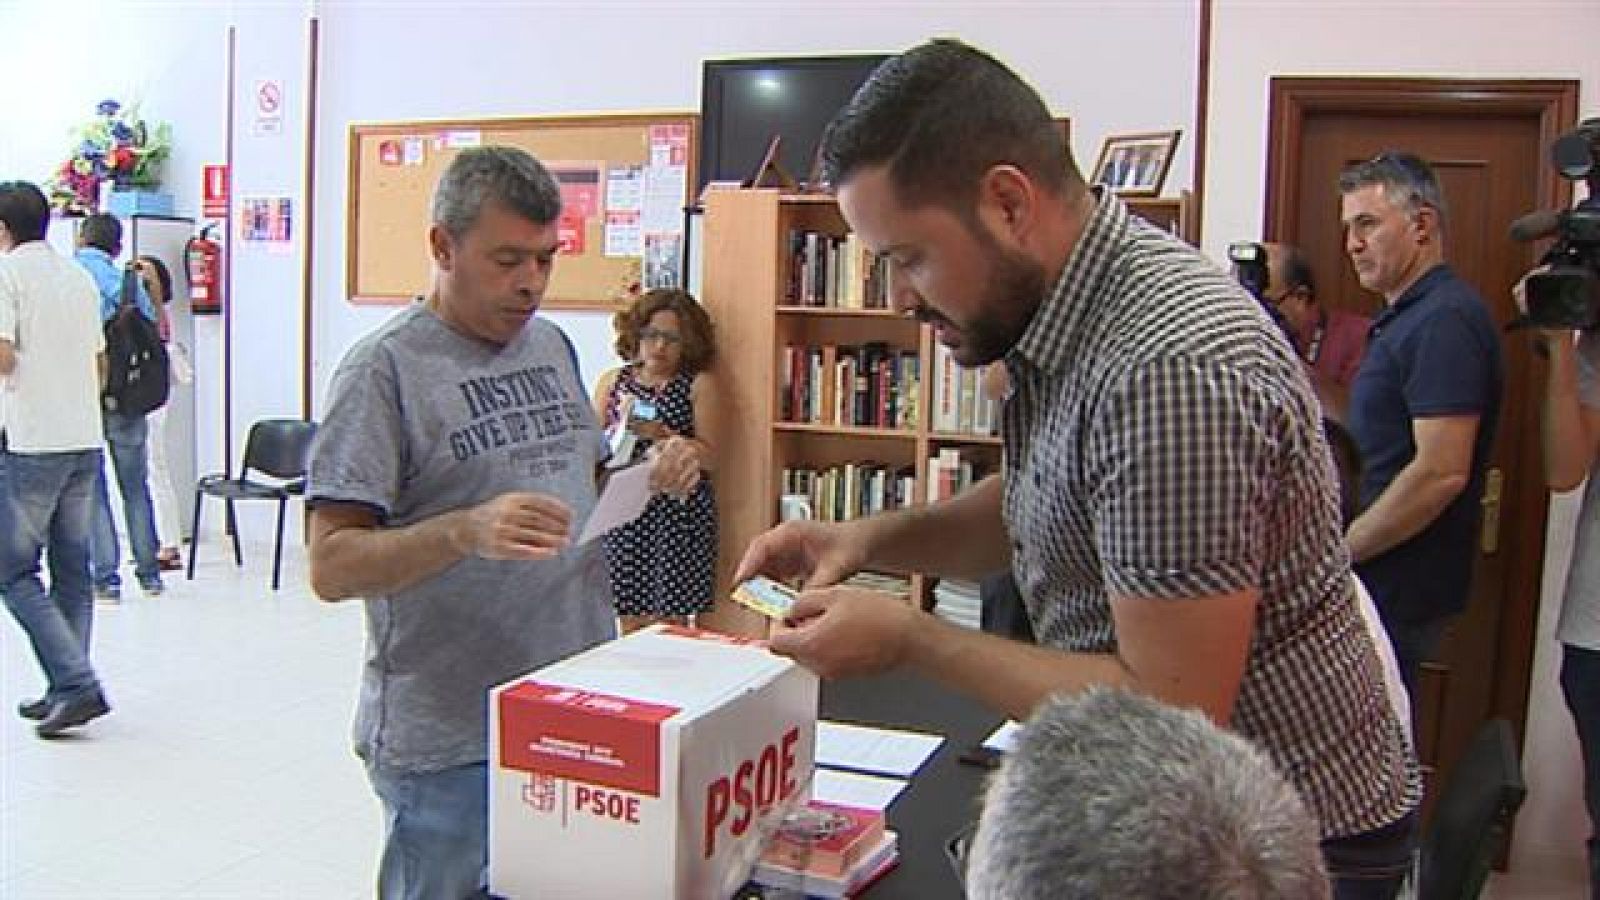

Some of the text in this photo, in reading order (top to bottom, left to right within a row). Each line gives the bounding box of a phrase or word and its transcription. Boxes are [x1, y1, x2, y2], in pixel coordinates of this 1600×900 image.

[449, 418, 506, 462] GIVE
[575, 785, 641, 824] PSOE
[703, 726, 798, 860] PSOE
